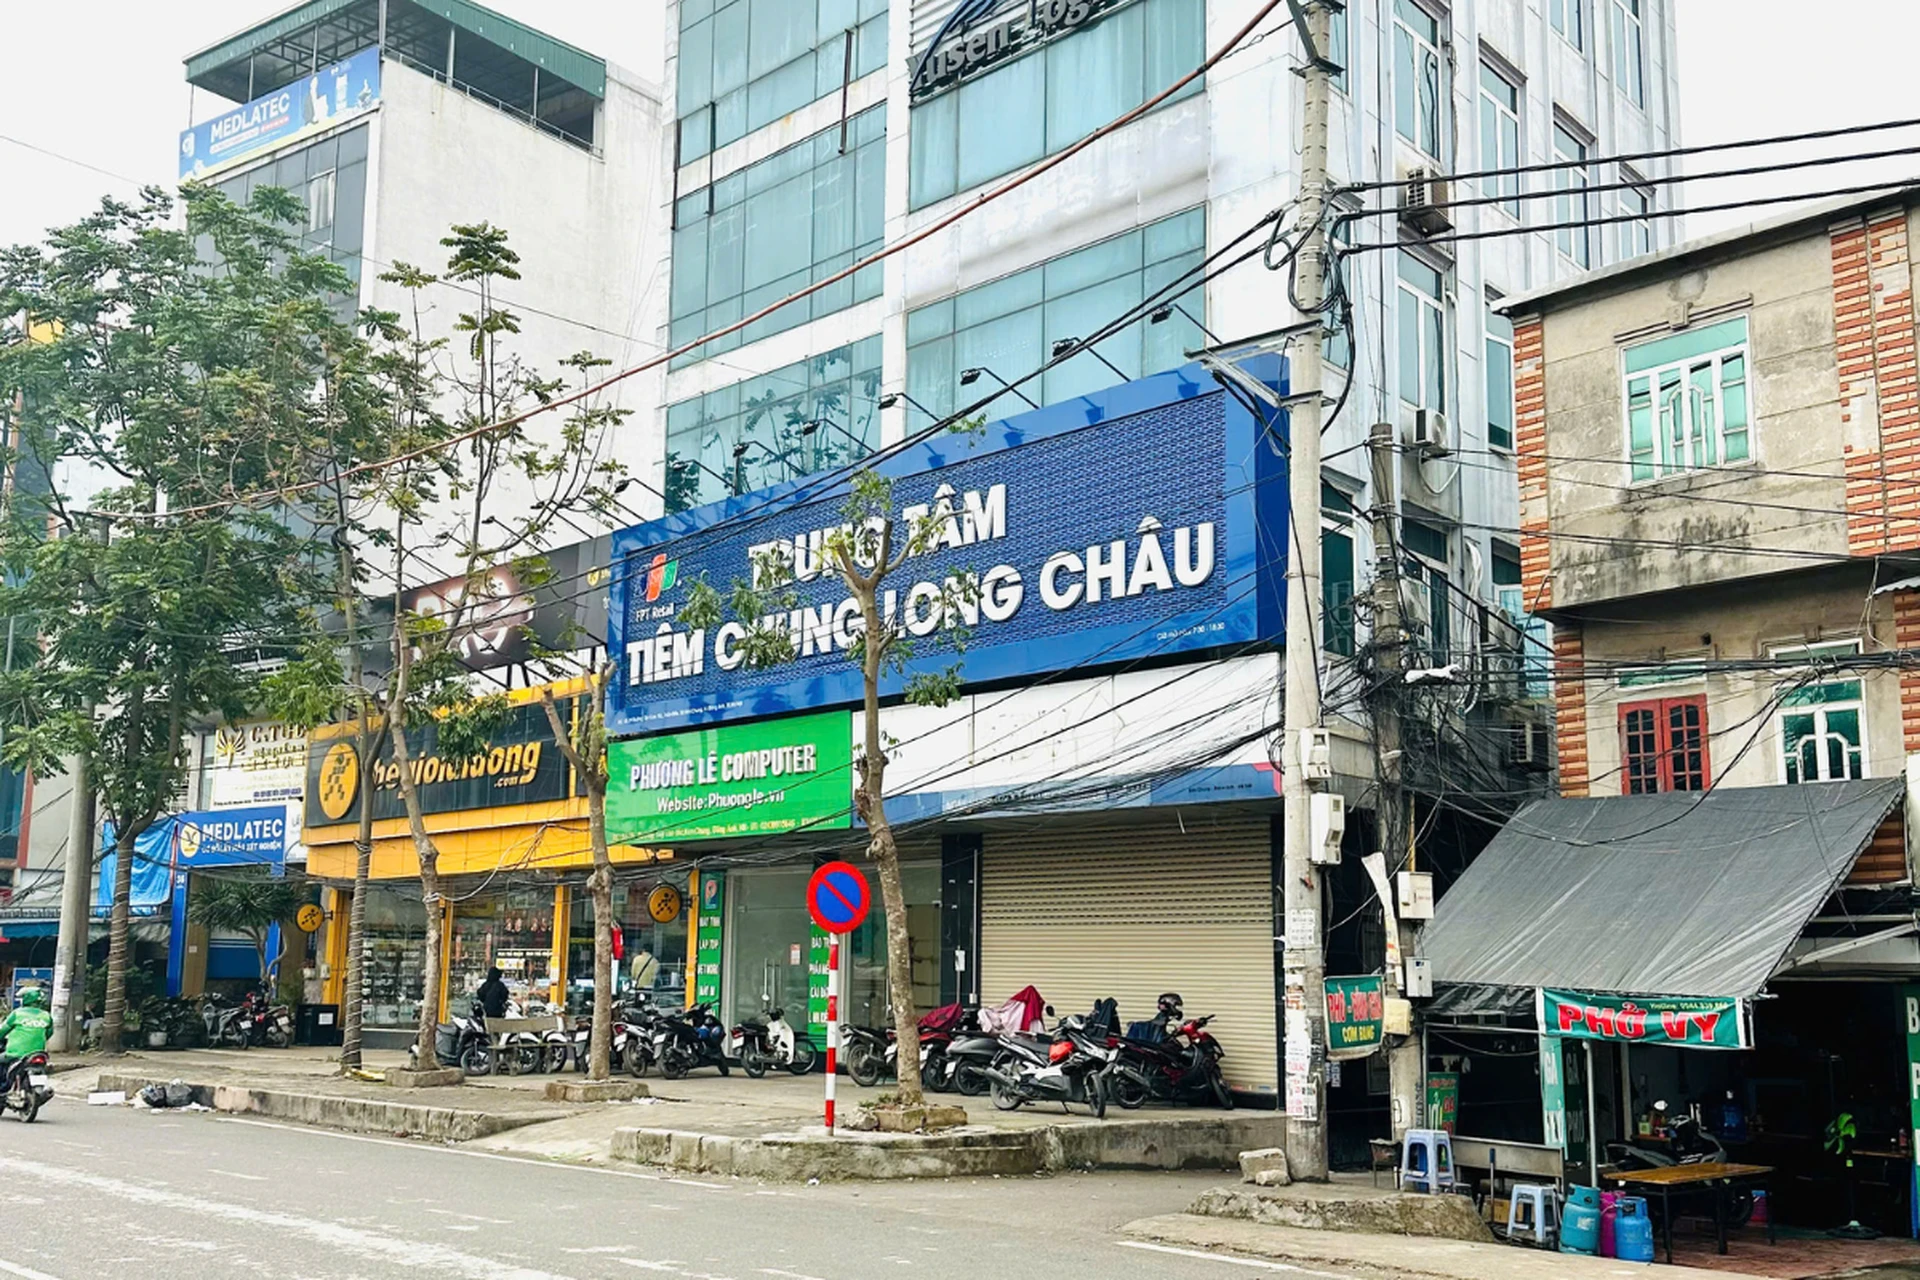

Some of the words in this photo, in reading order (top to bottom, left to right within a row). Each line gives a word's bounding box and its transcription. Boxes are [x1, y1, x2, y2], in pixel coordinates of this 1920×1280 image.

[211, 92, 290, 143] MEDLATEC
[902, 484, 1006, 557] TÂM
[626, 622, 705, 687] TIÊM
[1039, 516, 1214, 611] CHÂU
[636, 608, 650, 621] FPT
[652, 603, 675, 620] Retail
[629, 759, 696, 792] PHƯƠNG
[698, 750, 718, 785] LÊ
[721, 744, 817, 783] COMPUTER
[202, 818, 284, 842] MEDLATEC
[1558, 1002, 1649, 1039] PHỞ
[1661, 1011, 1721, 1042] VY
